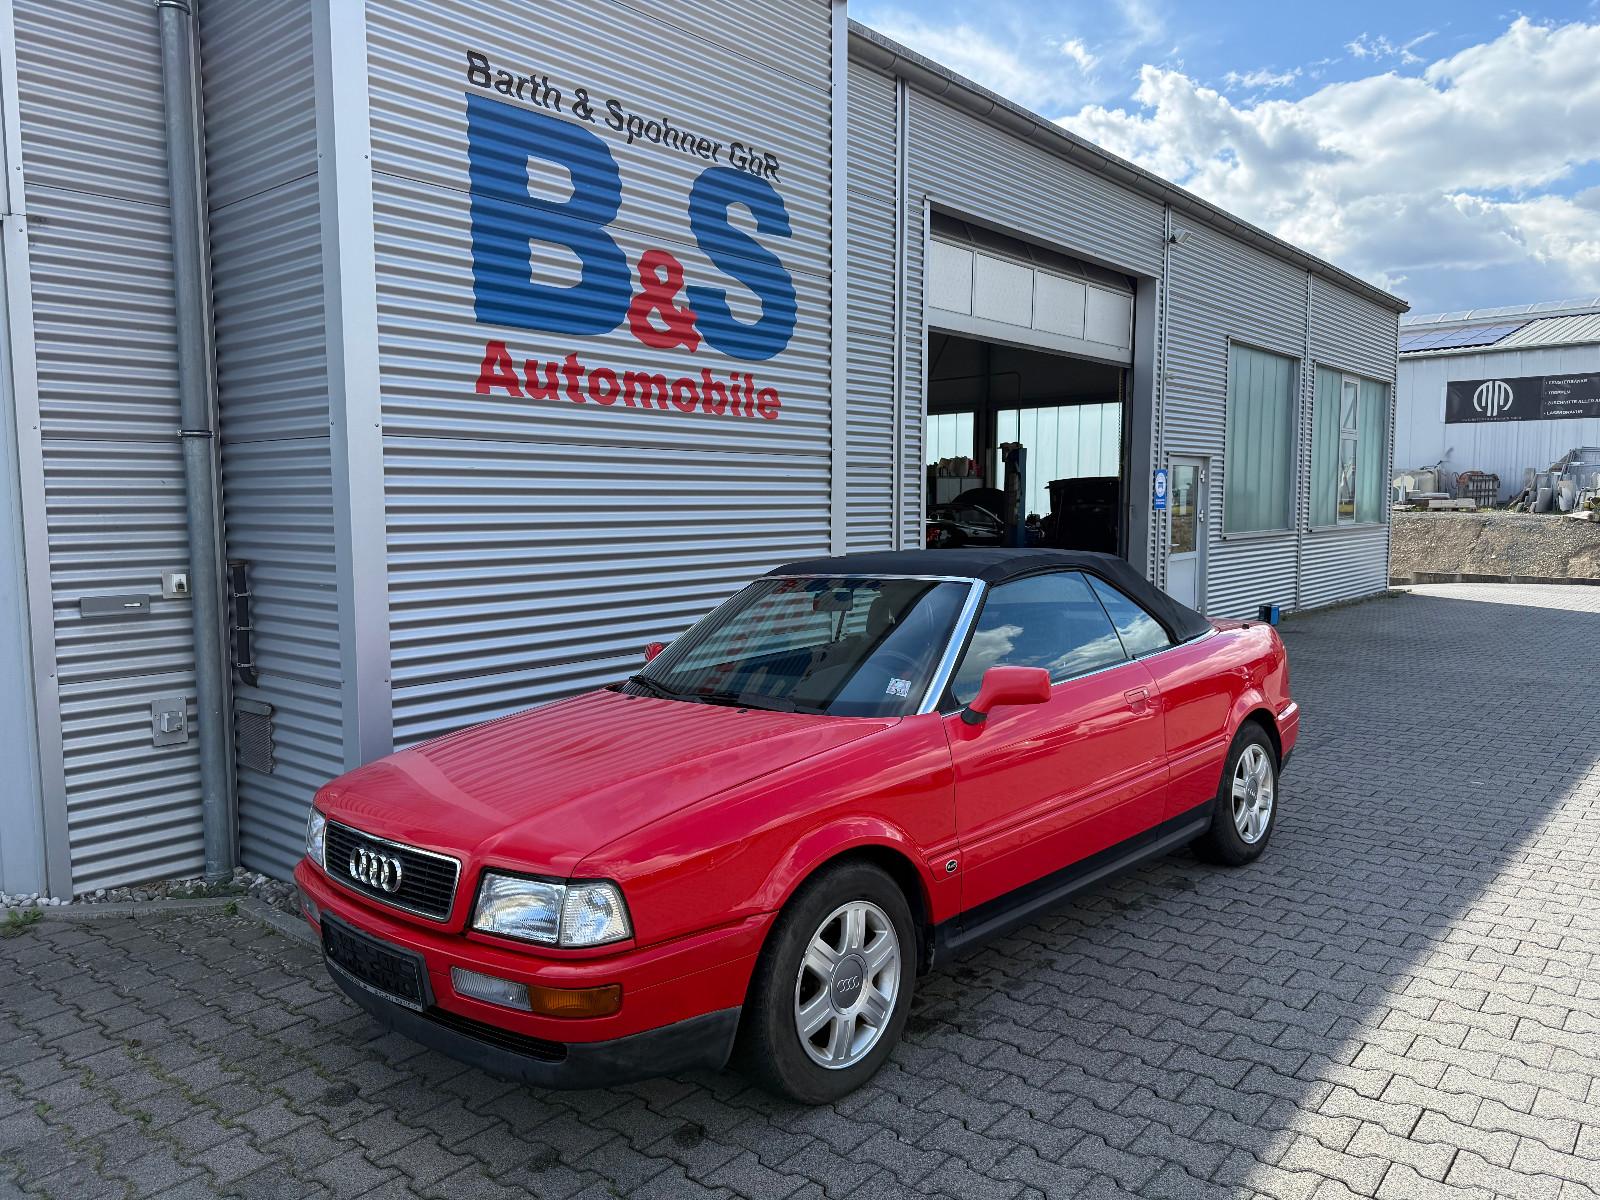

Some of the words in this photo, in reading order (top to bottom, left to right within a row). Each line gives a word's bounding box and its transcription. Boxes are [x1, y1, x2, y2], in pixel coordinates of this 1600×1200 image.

[466, 50, 562, 112] Barth
[572, 88, 596, 124] &
[605, 100, 722, 162] Spohner
[729, 142, 781, 183] GbR
[465, 92, 798, 361] B&S
[475, 340, 782, 420] Automobile
